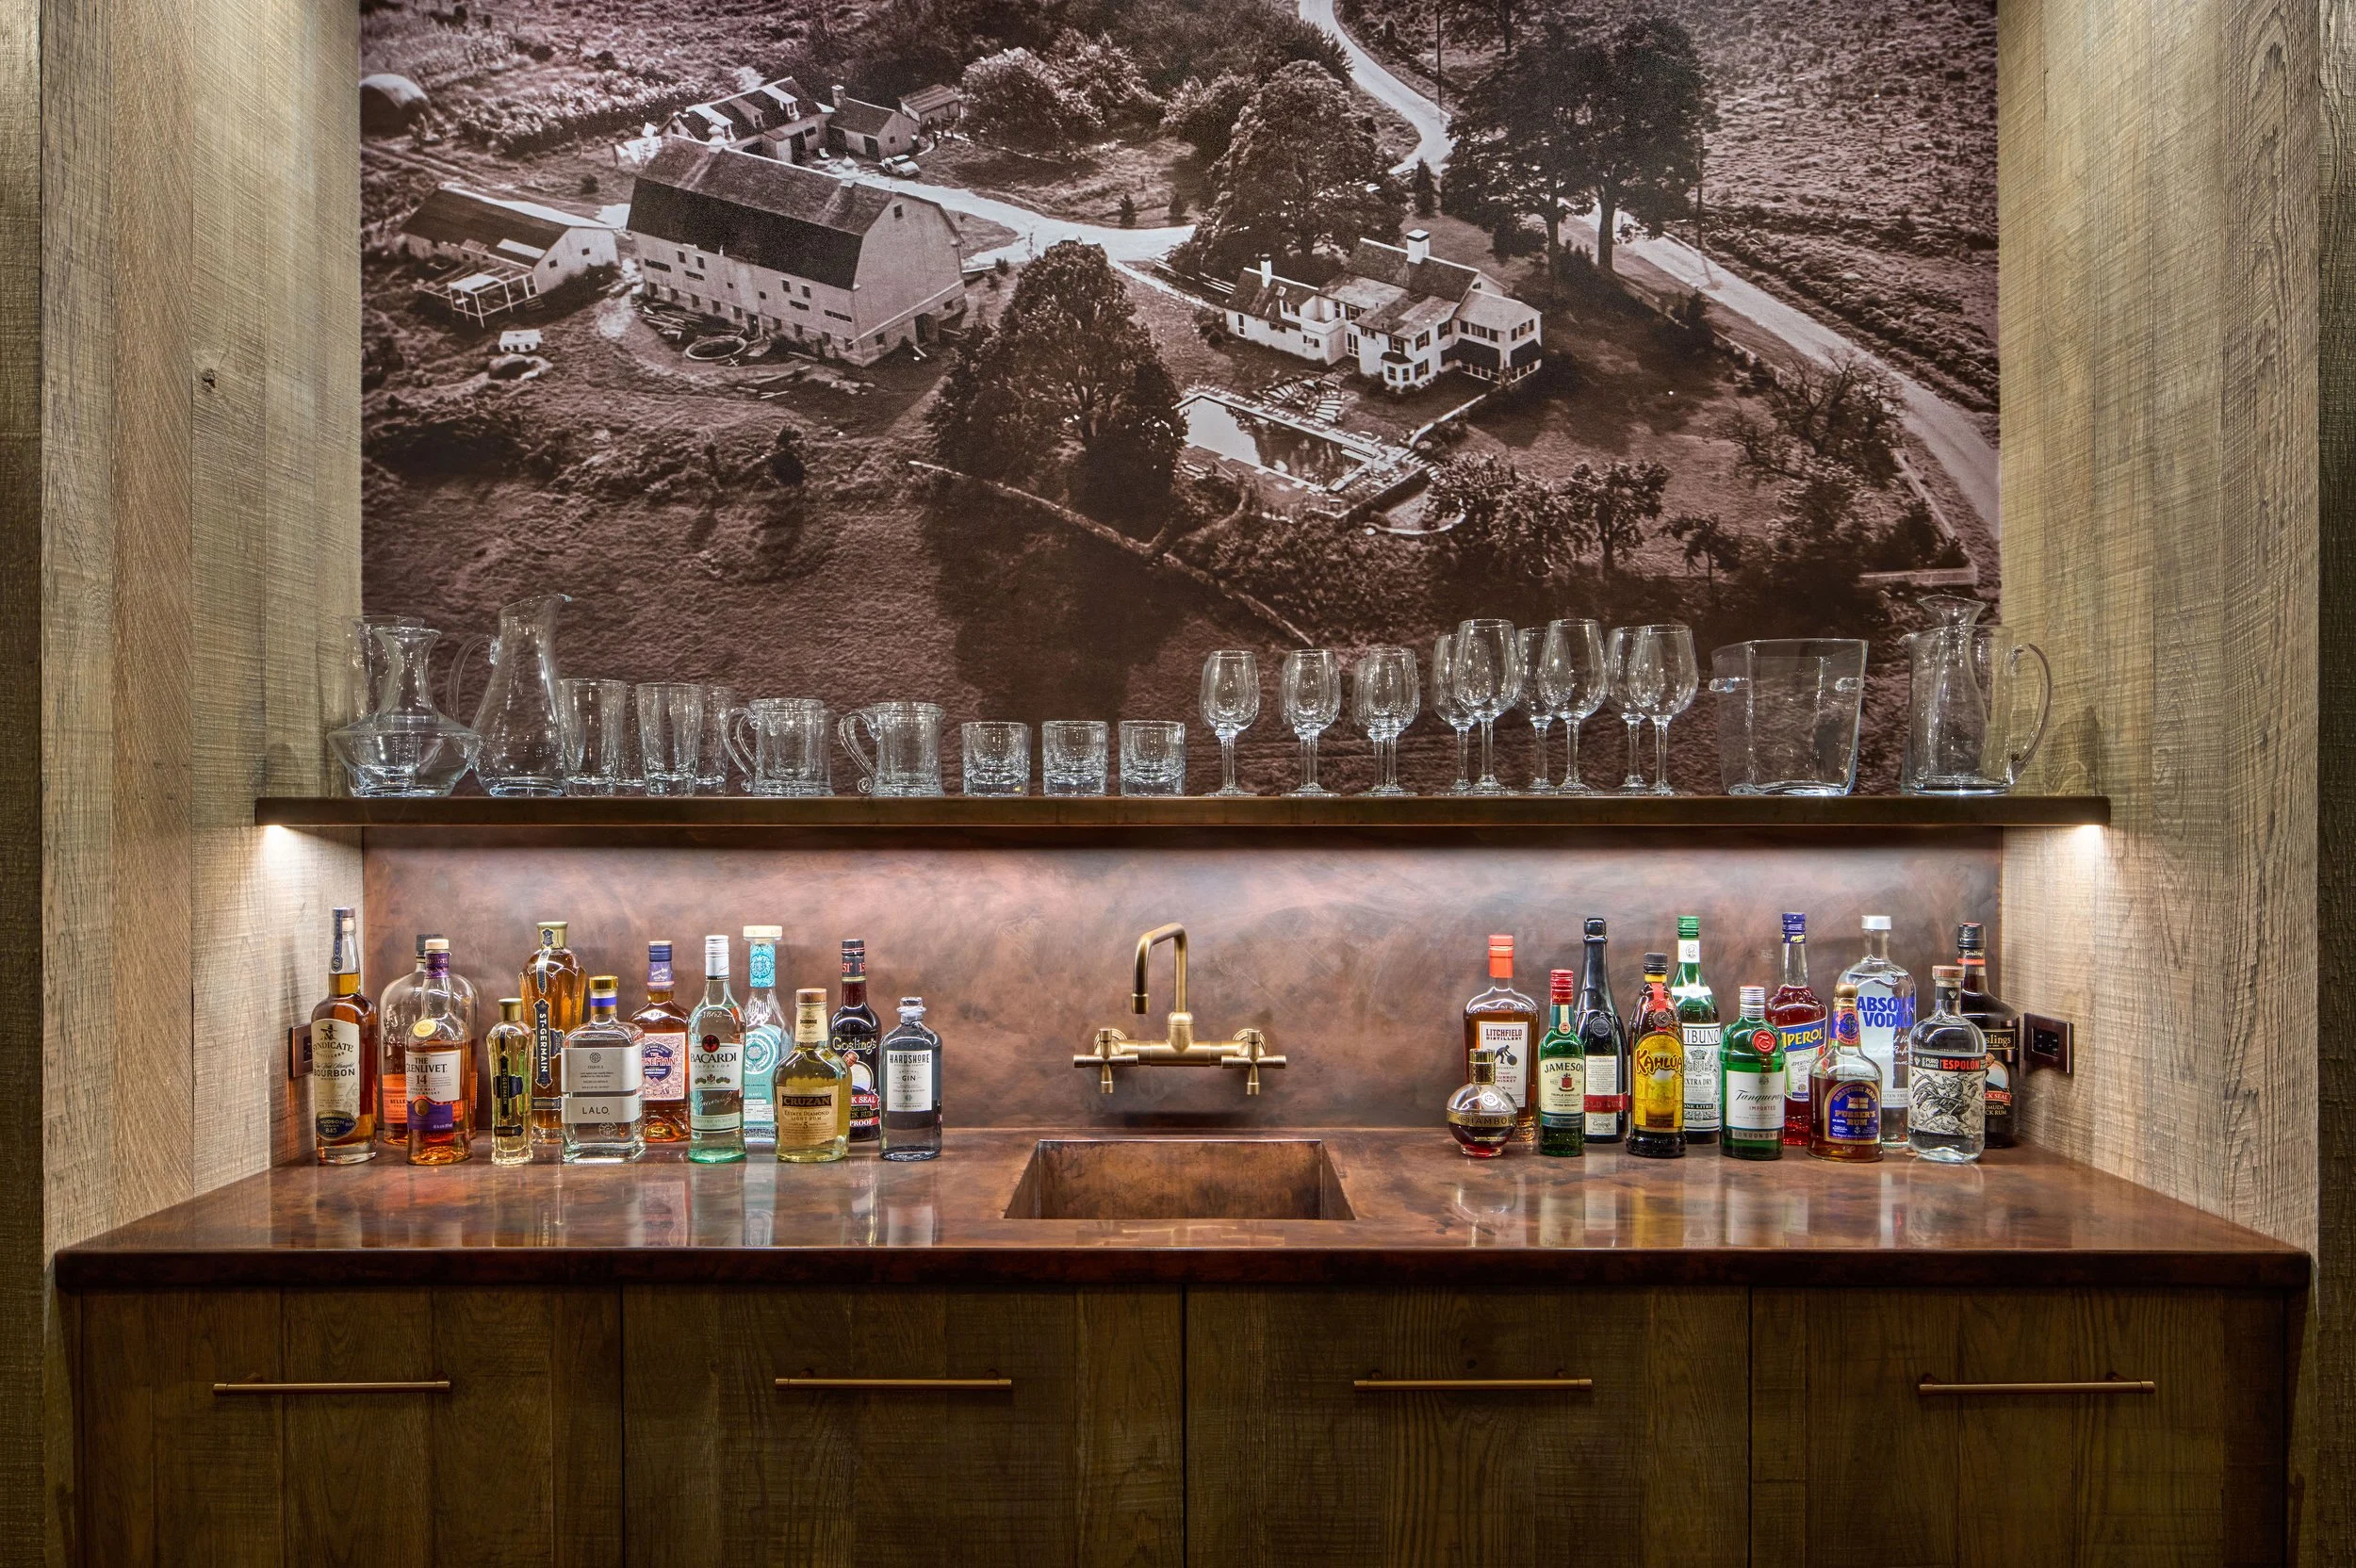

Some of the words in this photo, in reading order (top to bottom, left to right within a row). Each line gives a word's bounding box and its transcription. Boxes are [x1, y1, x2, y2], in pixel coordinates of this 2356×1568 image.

[1857, 996, 1915, 1013] ABSOLU
[1862, 1012, 1913, 1028] VODKA
[1486, 1028, 1523, 1037] LITCHFIELD
[1684, 1029, 1720, 1044] IBUNO
[539, 1012, 549, 1073] ST-GERMAIN
[1986, 1035, 2012, 1047] slings
[690, 1052, 738, 1064] BACARDI
[890, 1054, 930, 1063] HARDSHORE
[1635, 1049, 1683, 1075] KAHLÚA
[314, 1068, 355, 1078] BOURBON
[417, 1075, 427, 1085] 14
[783, 1096, 830, 1106] CRUZAN
[858, 1095, 876, 1103] SEAL
[1735, 1089, 1784, 1104] Tanqueray
[581, 1106, 610, 1116] LALO
[849, 1119, 873, 1127] PROOF
[1846, 1118, 1869, 1127] RUM
